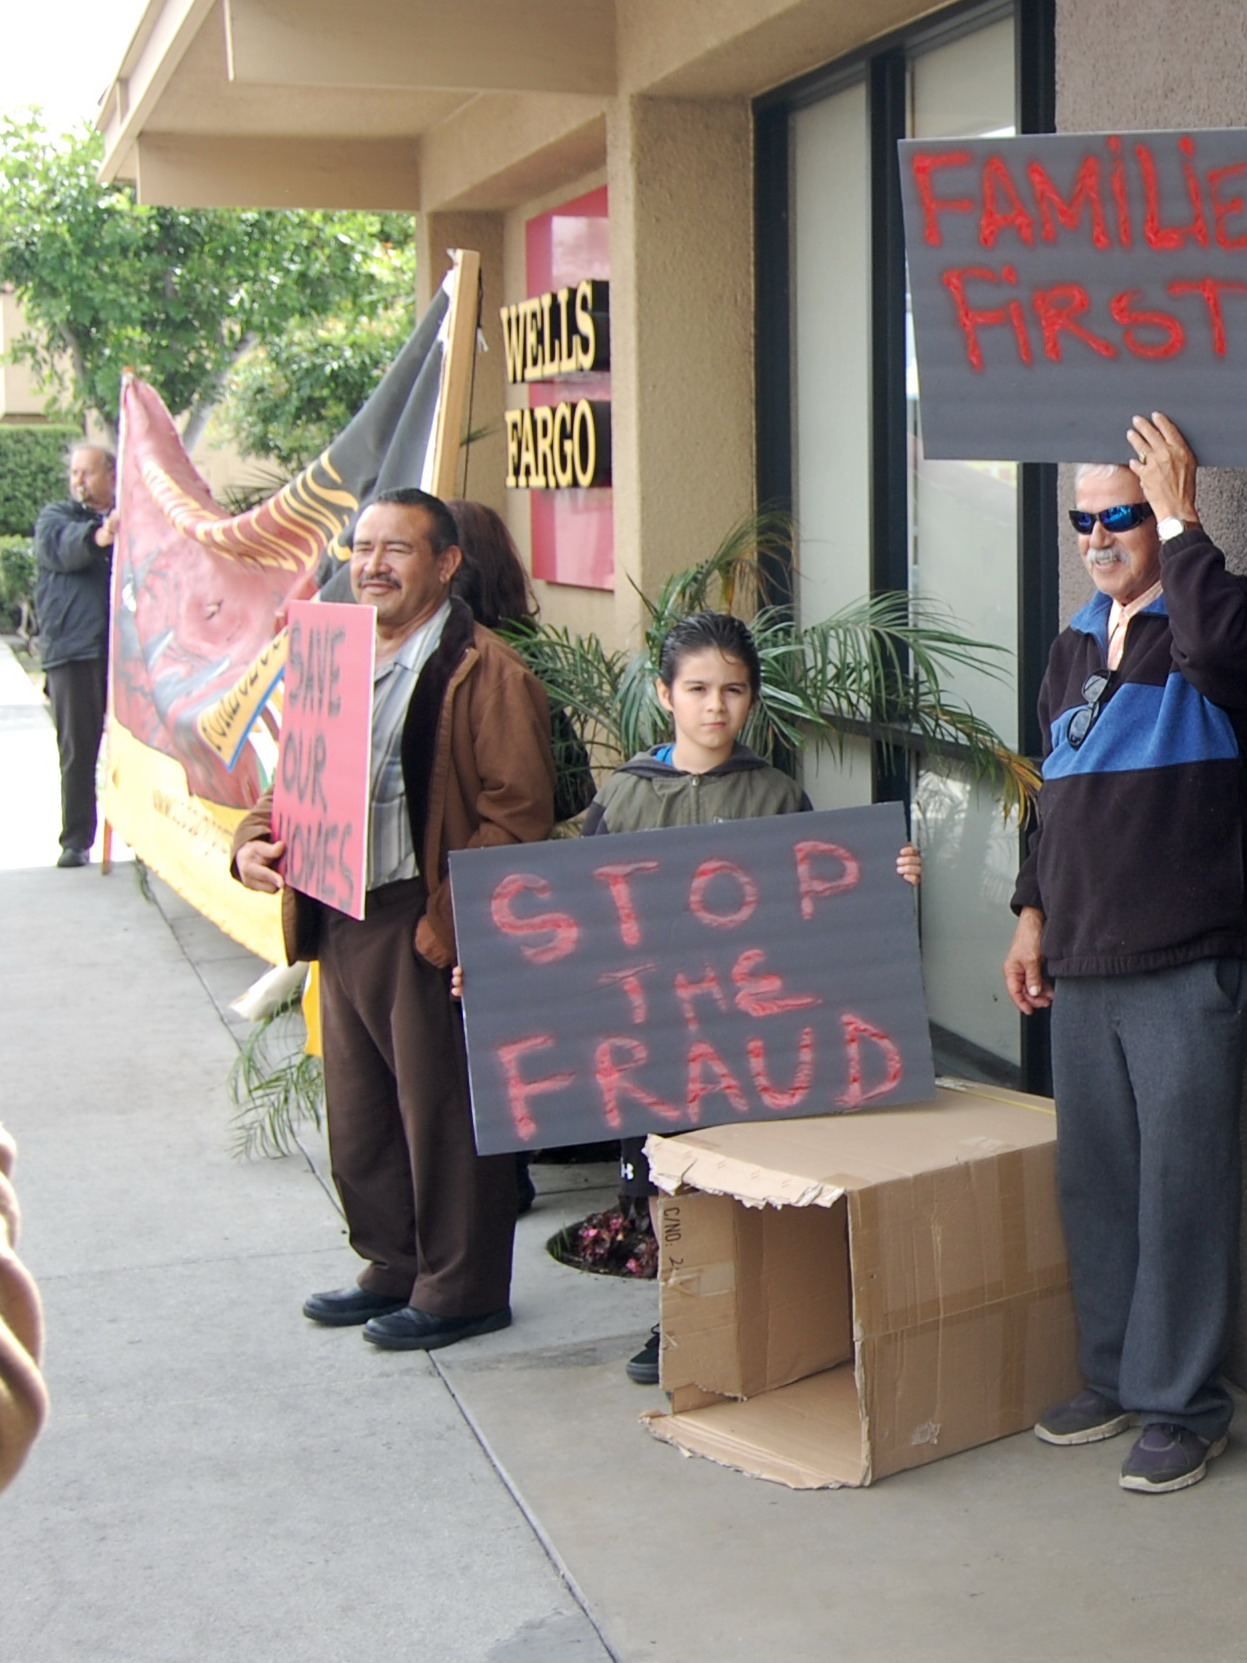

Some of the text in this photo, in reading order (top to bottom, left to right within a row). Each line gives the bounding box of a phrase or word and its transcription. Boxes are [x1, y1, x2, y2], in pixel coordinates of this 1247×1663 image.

[500, 279, 596, 383] WELLS
[505, 398, 596, 488] FARGO
[287, 620, 346, 719] SAVE
[282, 729, 328, 815] OUR
[278, 812, 355, 914] HOMES
[490, 840, 861, 964] STOP
[598, 949, 822, 1031] THE
[497, 1013, 902, 1141] FRAUD
